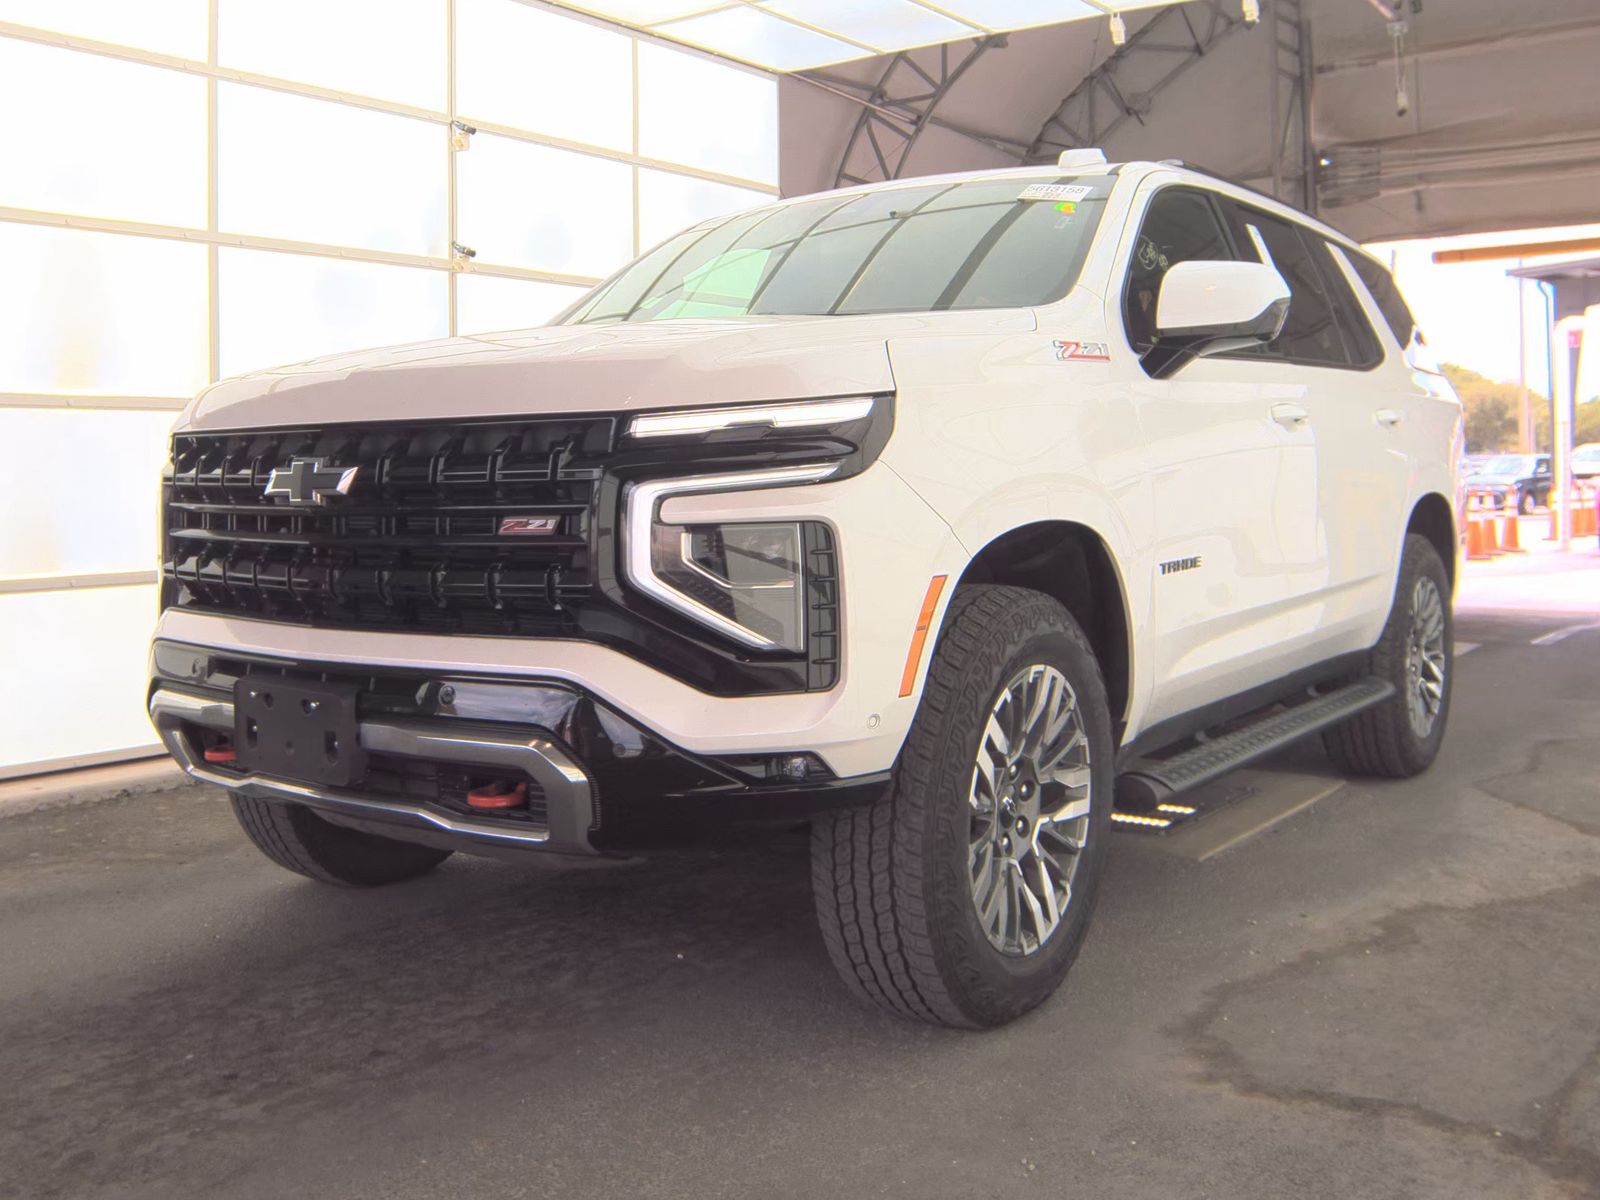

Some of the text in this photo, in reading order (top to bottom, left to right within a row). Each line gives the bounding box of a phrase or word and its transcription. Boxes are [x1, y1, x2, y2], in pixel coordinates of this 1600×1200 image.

[1053, 340, 1111, 361] Z71
[499, 518, 557, 534] Z71
[1159, 556, 1202, 575] TAHOE
